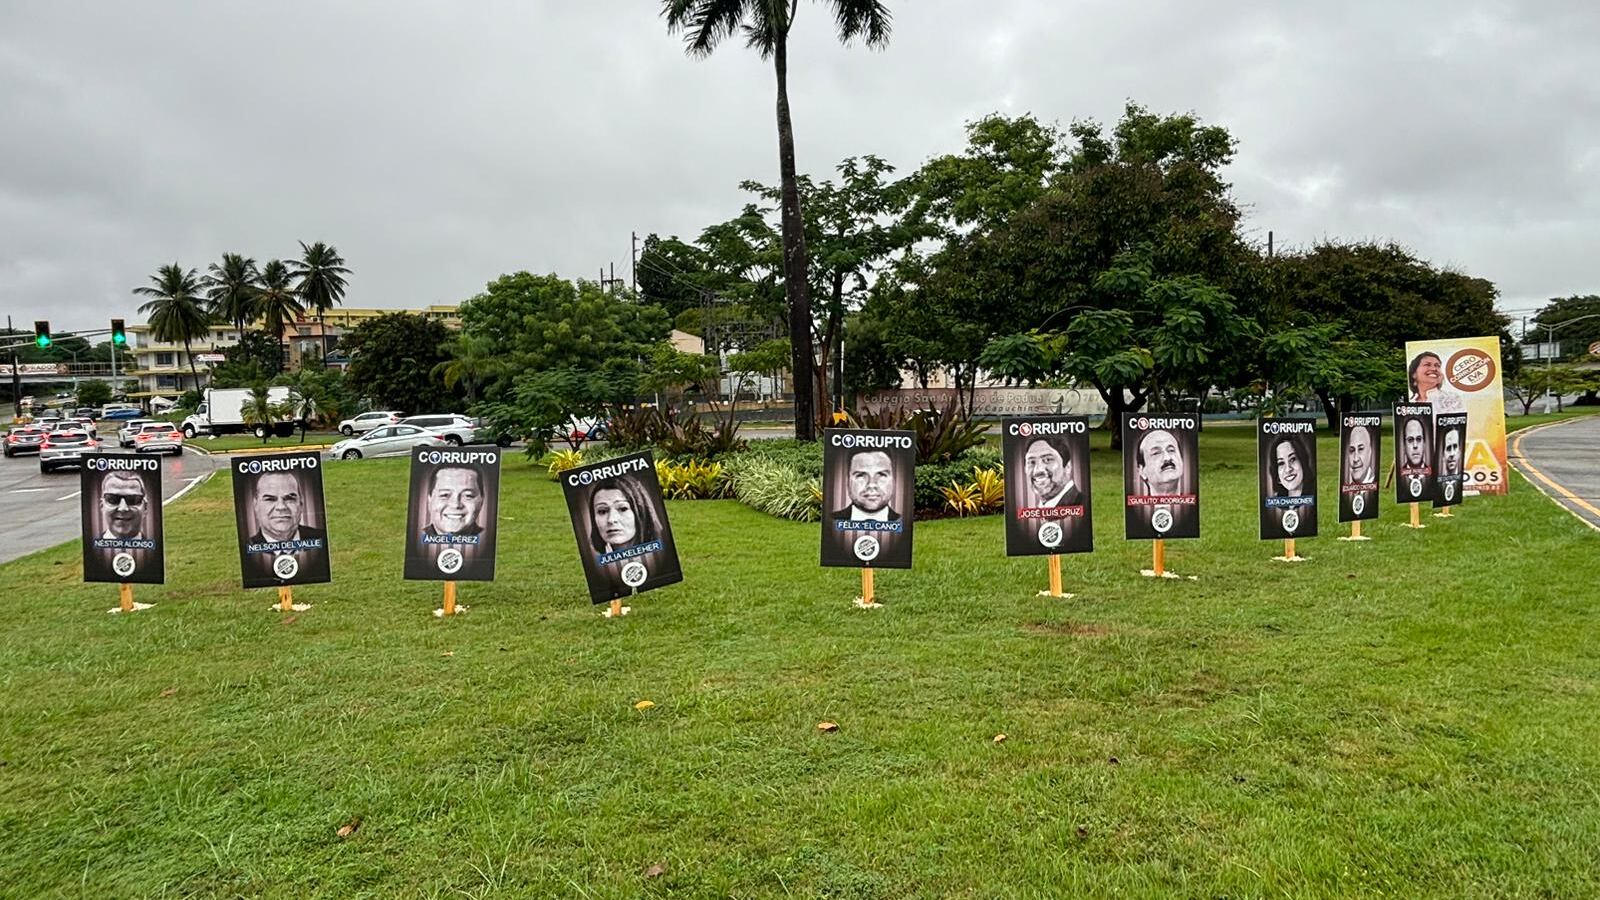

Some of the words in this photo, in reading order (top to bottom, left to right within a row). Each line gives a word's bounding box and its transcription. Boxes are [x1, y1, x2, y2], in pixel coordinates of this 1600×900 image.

[1455, 356, 1476, 371] CERO
[1467, 371, 1483, 382] EVA
[990, 391, 1005, 403] de
[1396, 406, 1431, 416] CORRUPTO
[1129, 417, 1195, 430] CORRUPTO
[1343, 416, 1380, 427] CORRUPTO
[1009, 422, 1085, 436] CORRUPTO
[1263, 422, 1314, 434] CORRUPTA
[832, 434, 912, 448] CORRUPTO
[419, 451, 497, 464] CORRUPTO
[87, 458, 158, 470] CORRUPTO
[239, 457, 317, 473] CORRUPTO
[568, 457, 650, 486] CORRUPTA
[1266, 498, 1280, 506] TATA
[1020, 509, 1040, 518] JOSÉ
[1042, 509, 1059, 517] LUIS
[1060, 507, 1081, 516] CRUZ
[838, 521, 860, 530] FÉLIX
[94, 539, 124, 548] NÉSTOR
[125, 540, 154, 548] ALONSO
[424, 534, 450, 543] ÁNGEL
[451, 534, 478, 543] PÉREZ
[249, 543, 280, 552] NELSON
[281, 541, 297, 549] DEL
[298, 539, 321, 548] VALLE
[600, 553, 621, 564] JULIA
[622, 541, 659, 559] KELEHER
